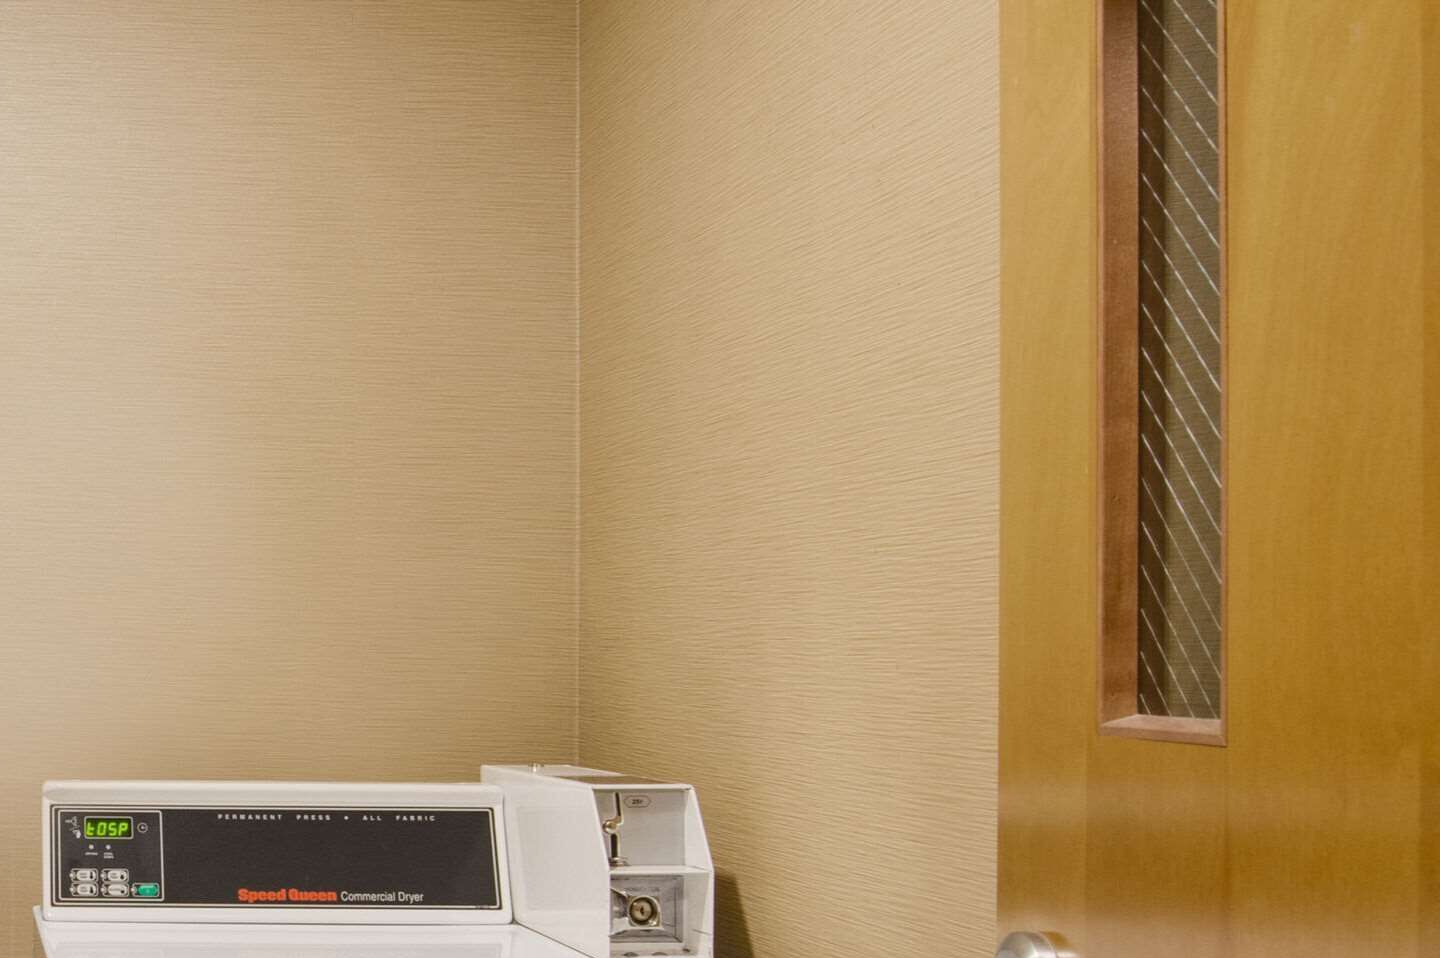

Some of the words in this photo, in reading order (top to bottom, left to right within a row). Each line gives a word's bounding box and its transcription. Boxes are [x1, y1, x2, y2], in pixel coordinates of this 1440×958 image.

[217, 813, 283, 821] PERMANENT
[395, 814, 436, 822] FABRIC
[238, 888, 287, 903] Speed
[288, 888, 337, 901] Queen
[340, 890, 396, 902] Commercial
[398, 891, 424, 904] Dryer
